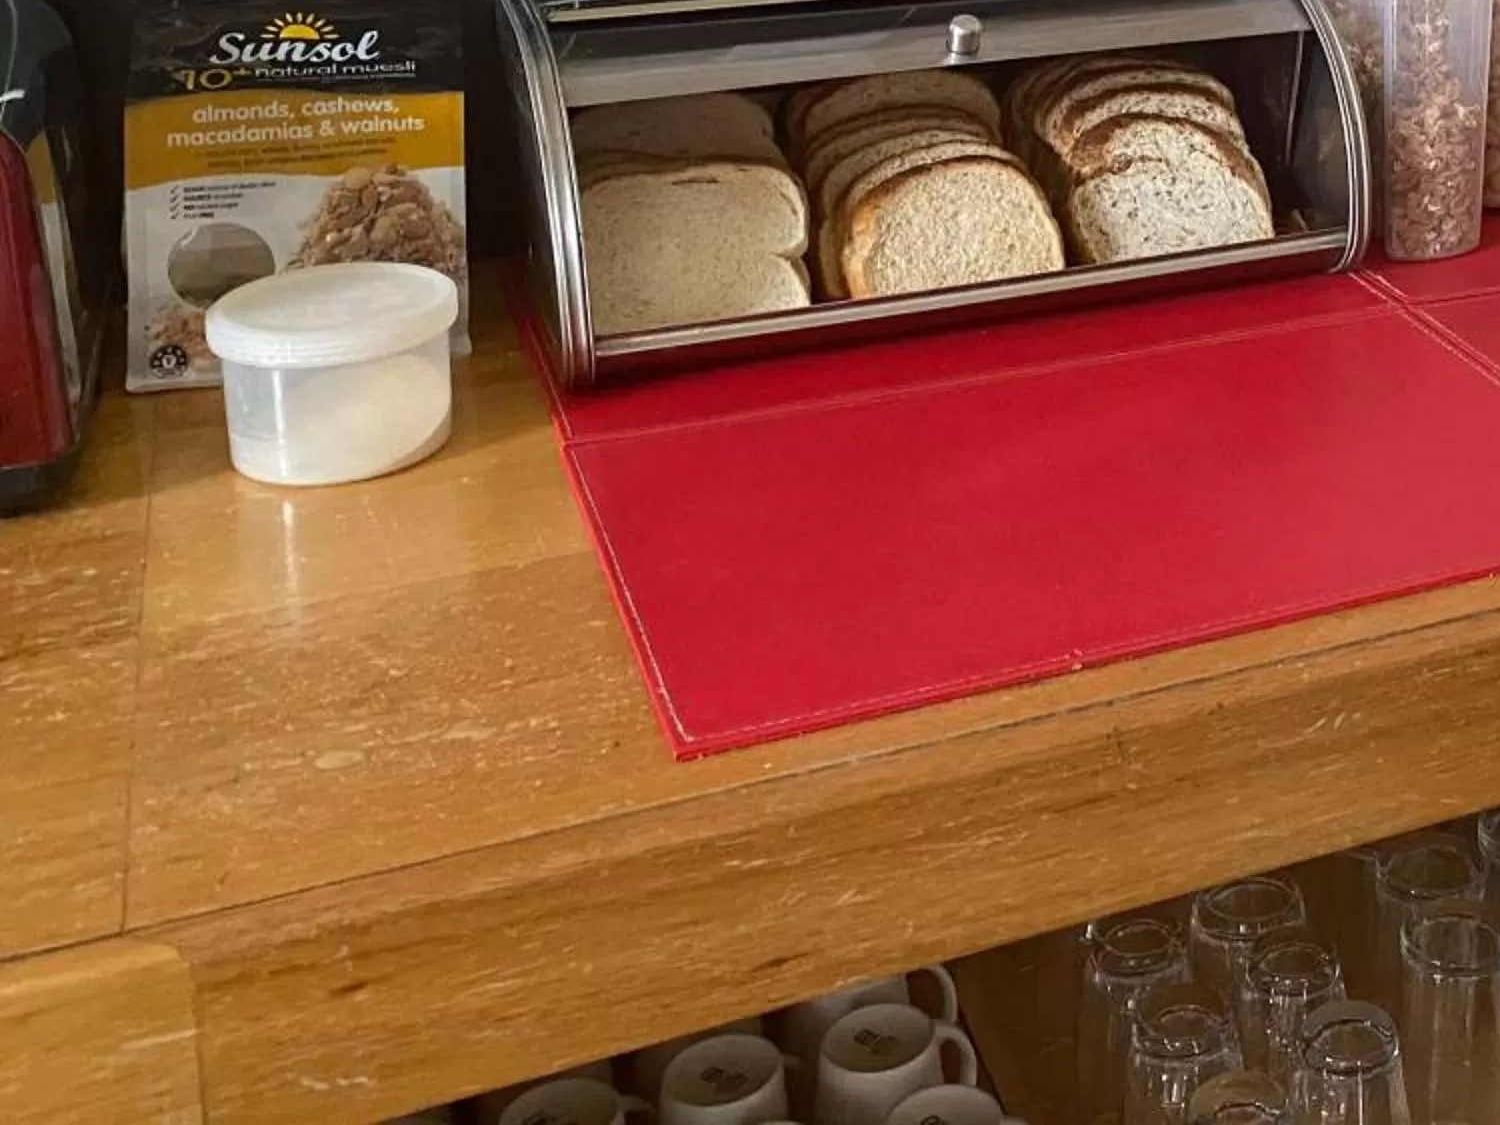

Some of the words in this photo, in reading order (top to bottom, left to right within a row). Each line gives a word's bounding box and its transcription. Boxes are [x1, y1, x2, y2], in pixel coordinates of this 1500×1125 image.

[208, 29, 380, 64] Sunsol
[254, 63, 338, 78] natural
[341, 59, 417, 75] muesli
[192, 100, 296, 124] almonds,
[301, 95, 400, 117] cashews,
[167, 122, 314, 148] macadamias
[319, 119, 335, 137] &
[340, 114, 426, 136] walnuts
